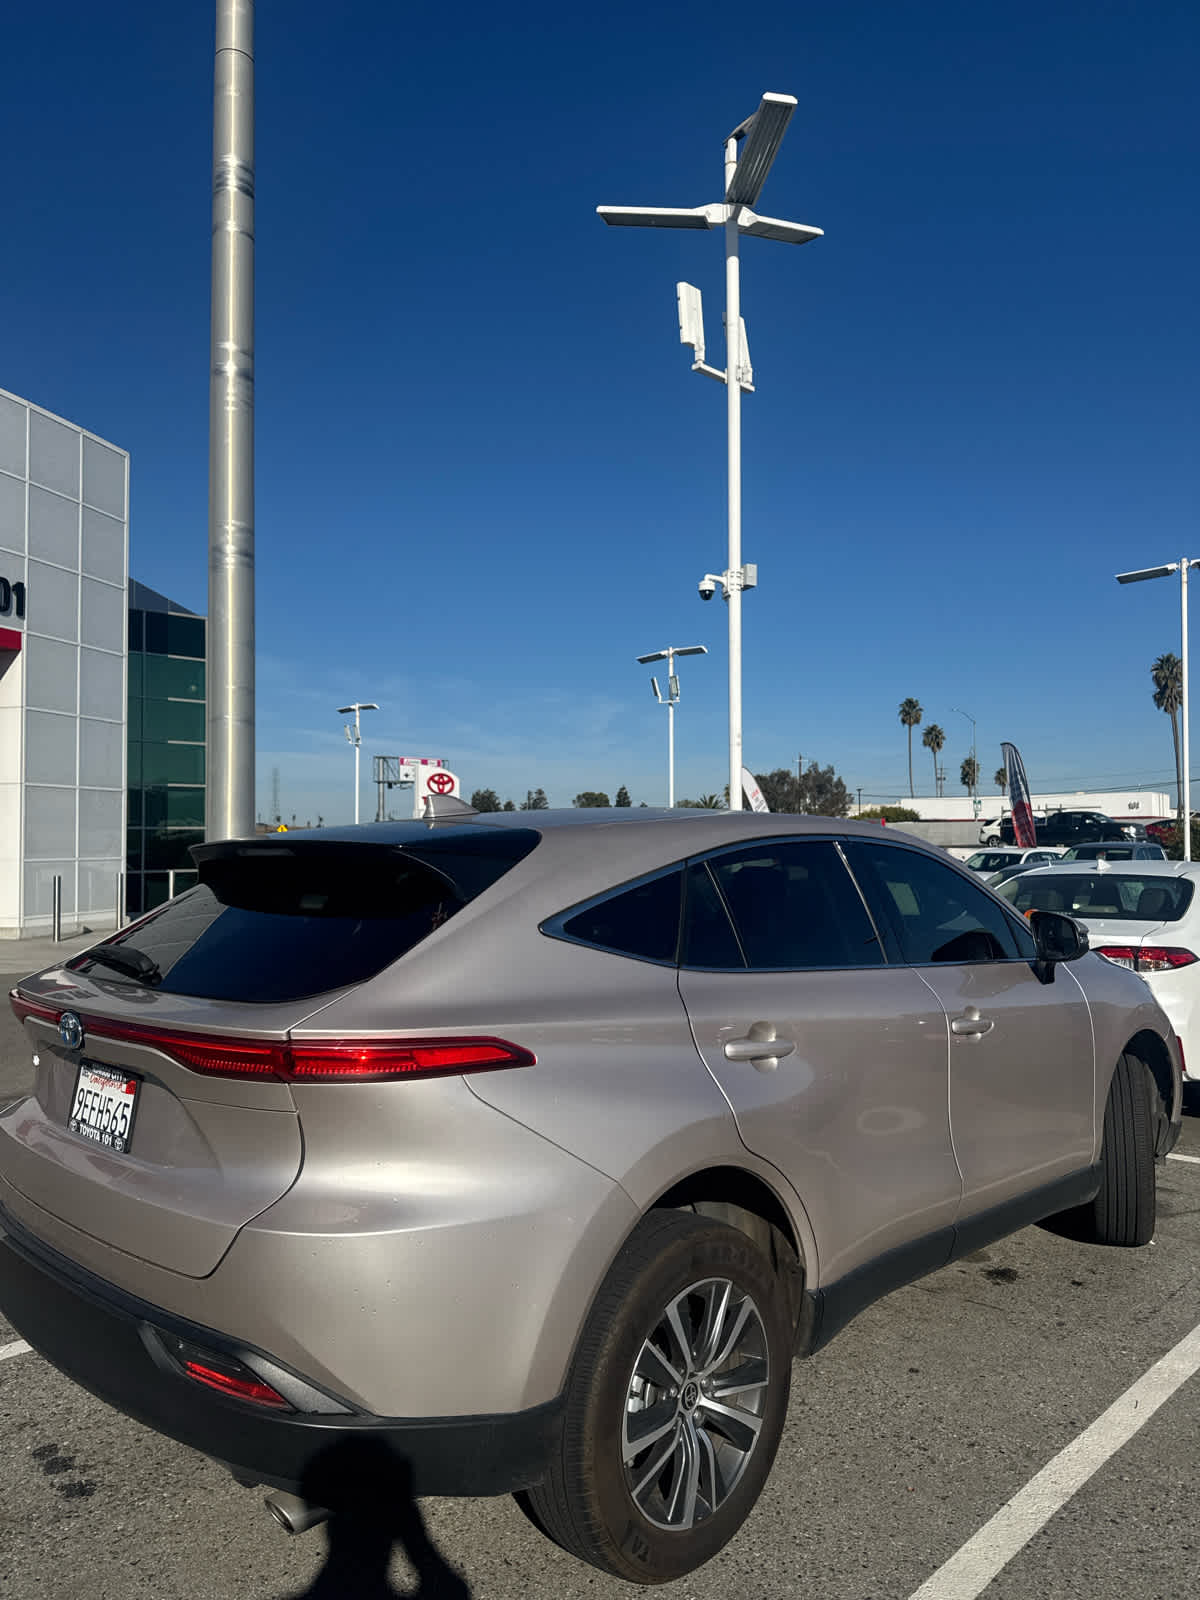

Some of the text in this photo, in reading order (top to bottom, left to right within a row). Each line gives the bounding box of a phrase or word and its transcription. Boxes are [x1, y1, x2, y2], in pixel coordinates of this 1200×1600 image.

[74, 1088, 130, 1137] 9EFH565
[79, 1123, 112, 1146] TOYOTA 101
